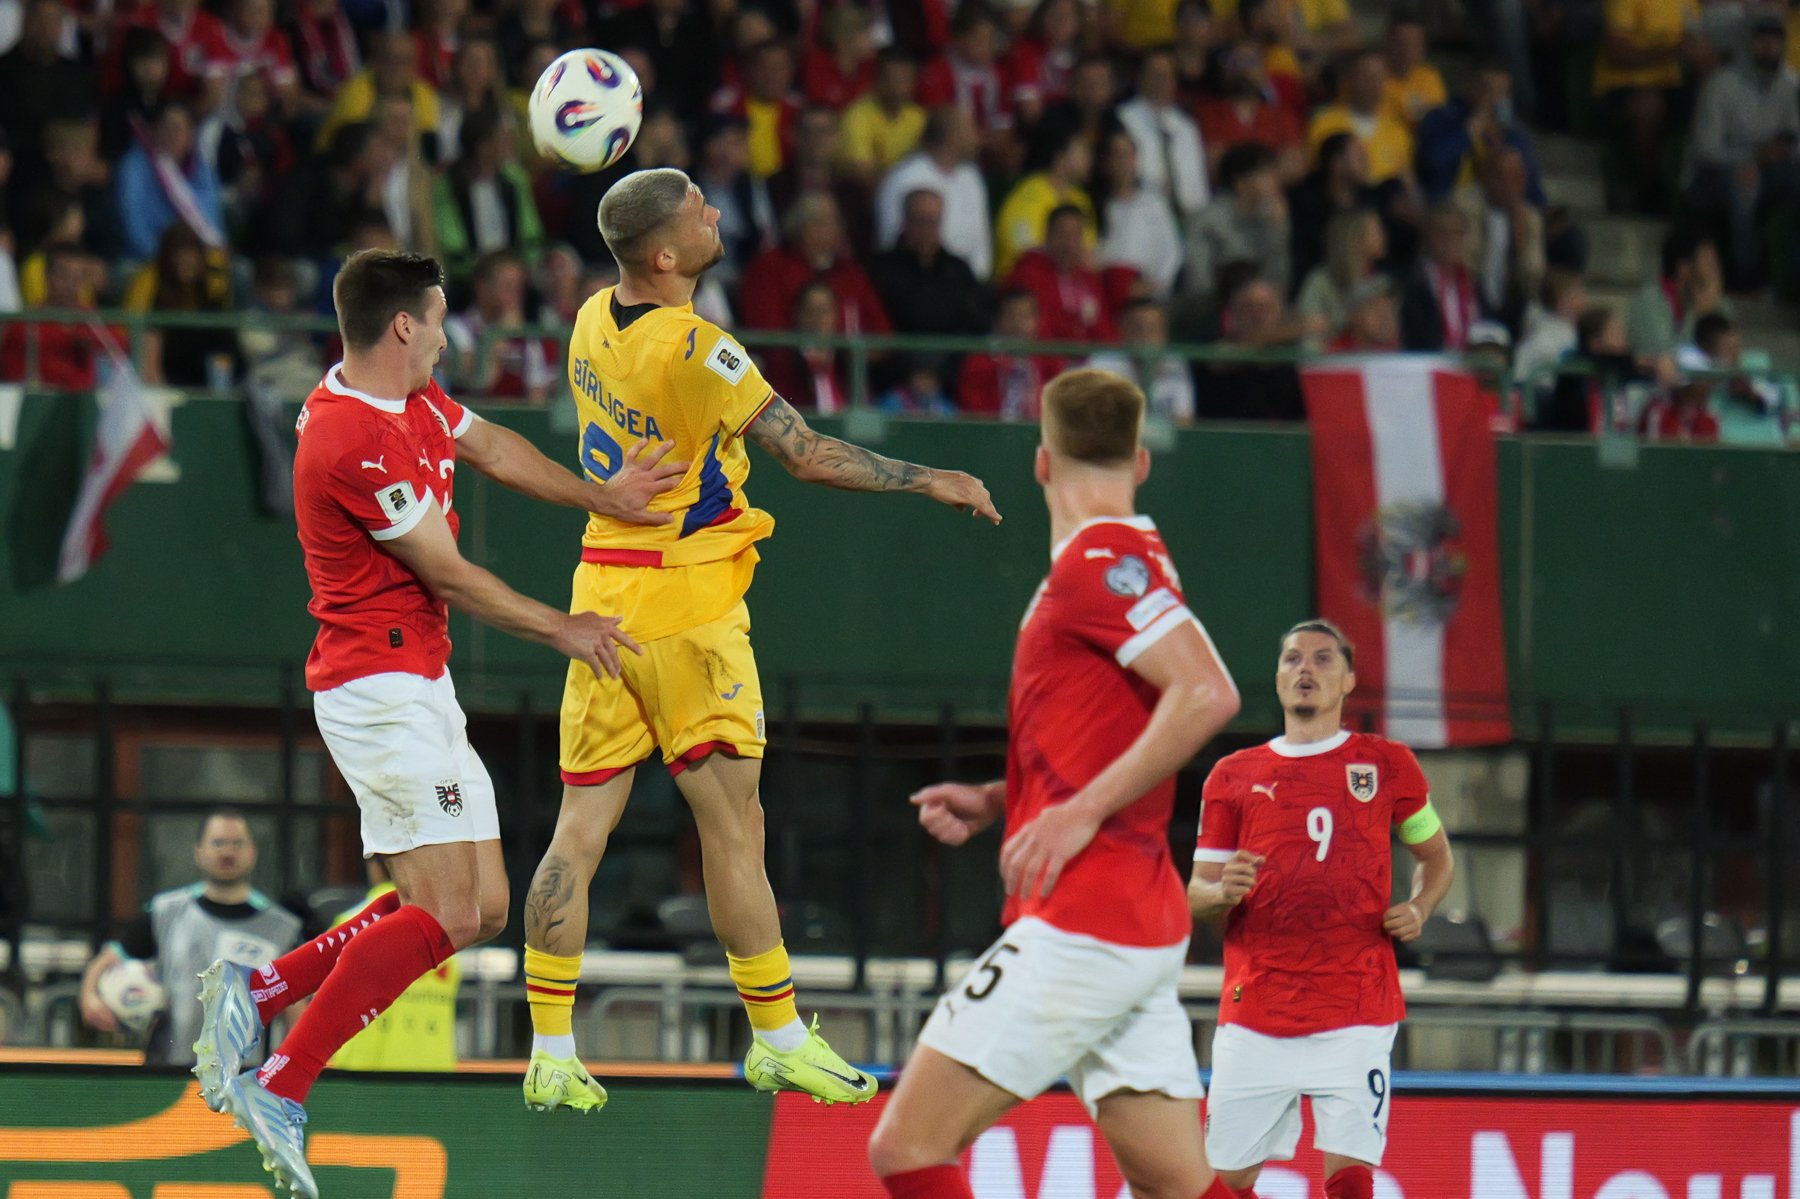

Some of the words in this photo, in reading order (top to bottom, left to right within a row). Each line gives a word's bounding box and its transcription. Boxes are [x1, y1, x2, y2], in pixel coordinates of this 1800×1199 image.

[1306, 806, 1333, 862] 9
[964, 943, 1019, 1001] 5
[1368, 1069, 1386, 1118] 9
